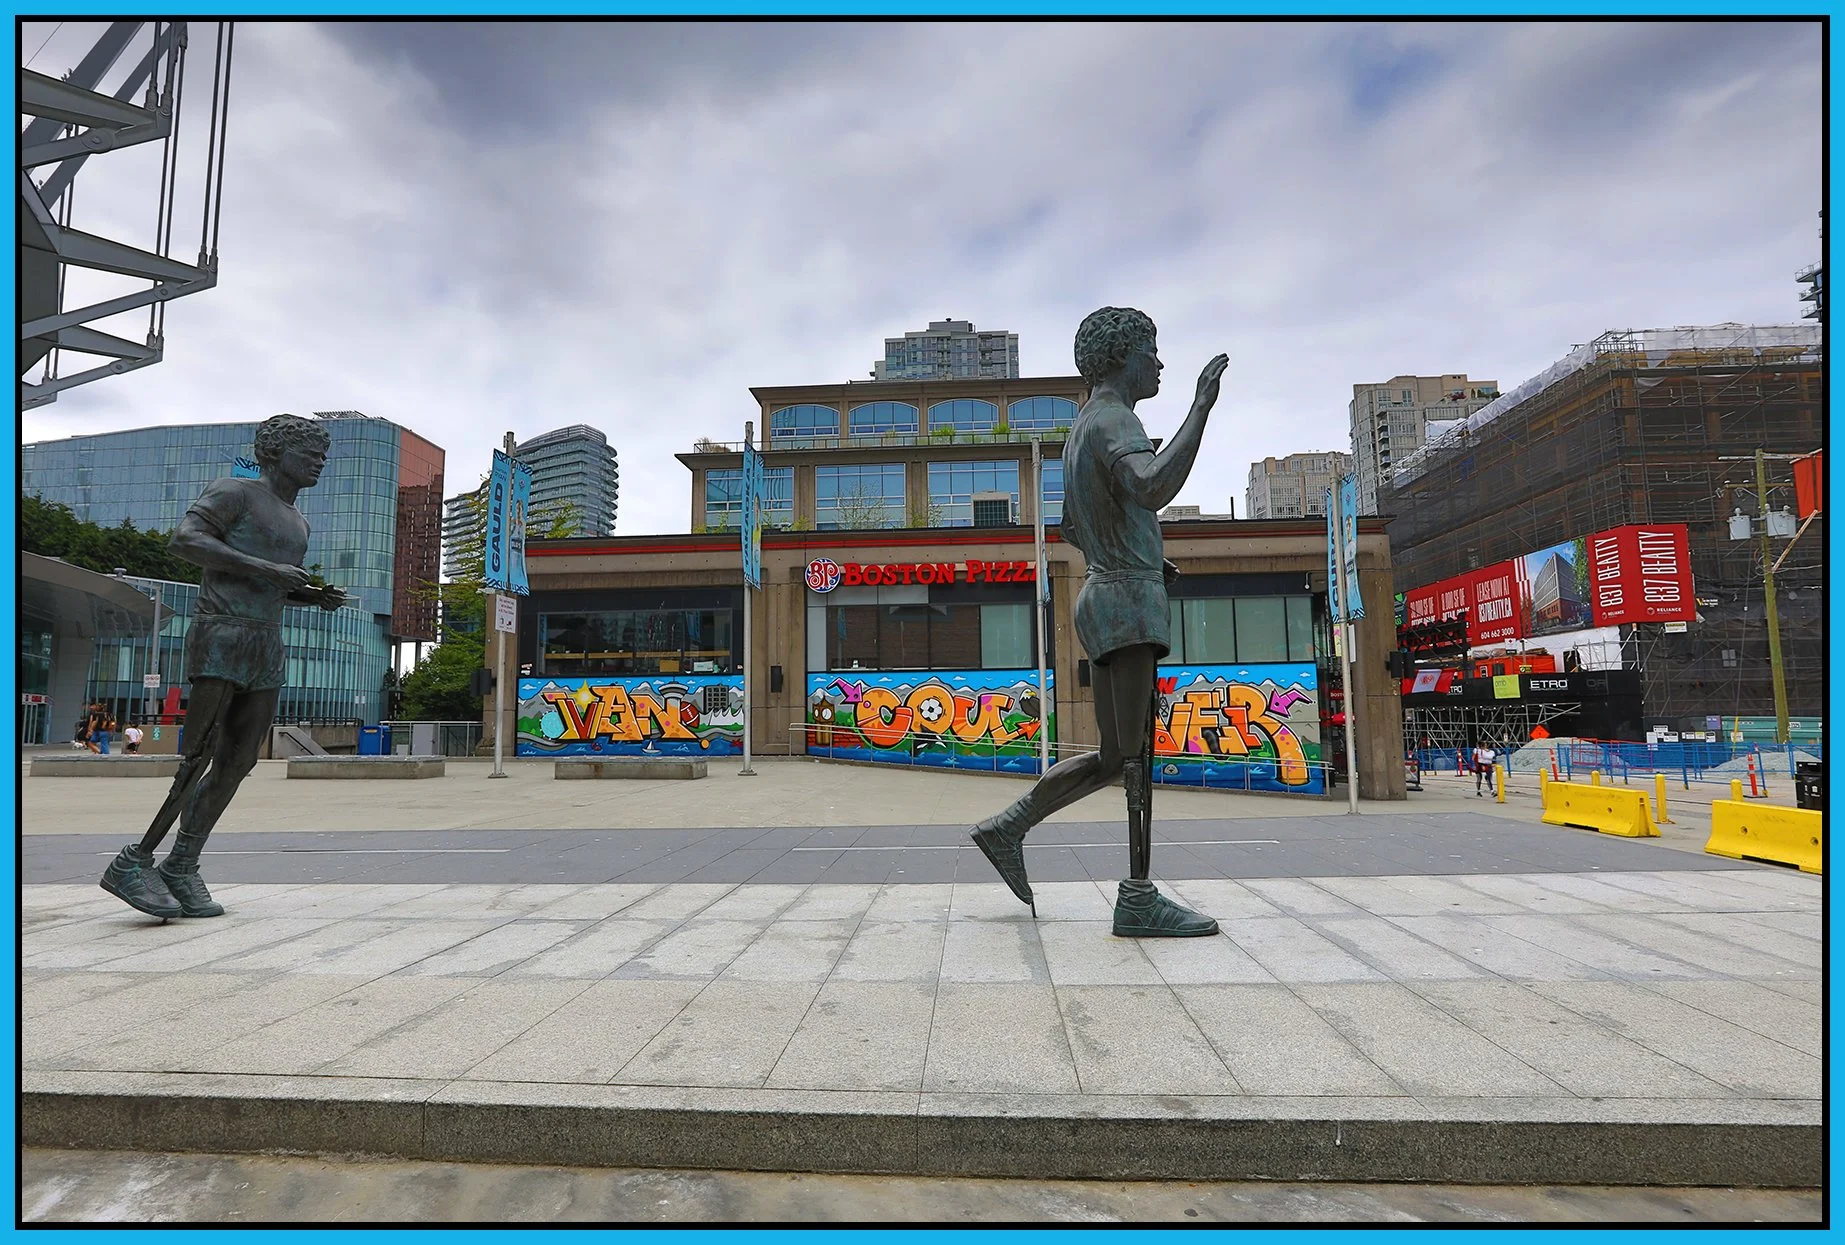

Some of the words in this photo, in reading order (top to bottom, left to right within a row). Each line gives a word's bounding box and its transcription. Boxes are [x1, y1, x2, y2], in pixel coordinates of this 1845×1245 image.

[491, 482, 504, 573] GAULD
[1594, 536, 1621, 581] BEATTY
[1638, 531, 1677, 575] BEATTY
[843, 562, 956, 586] BOSTON
[965, 560, 1037, 584] PIZZ
[1476, 580, 1491, 603] LEASE
[1489, 577, 1504, 600] NOW
[1503, 575, 1510, 596] AT
[1598, 584, 1624, 607] 837
[1643, 579, 1680, 602] 837
[1480, 630, 1490, 640] 604
[1490, 629, 1501, 638] 662
[1501, 626, 1515, 637] 3000
[1448, 685, 1463, 693] TRO
[1530, 679, 1568, 689] ETRO
[541, 685, 700, 742] VAN
[853, 684, 1025, 749] COU
